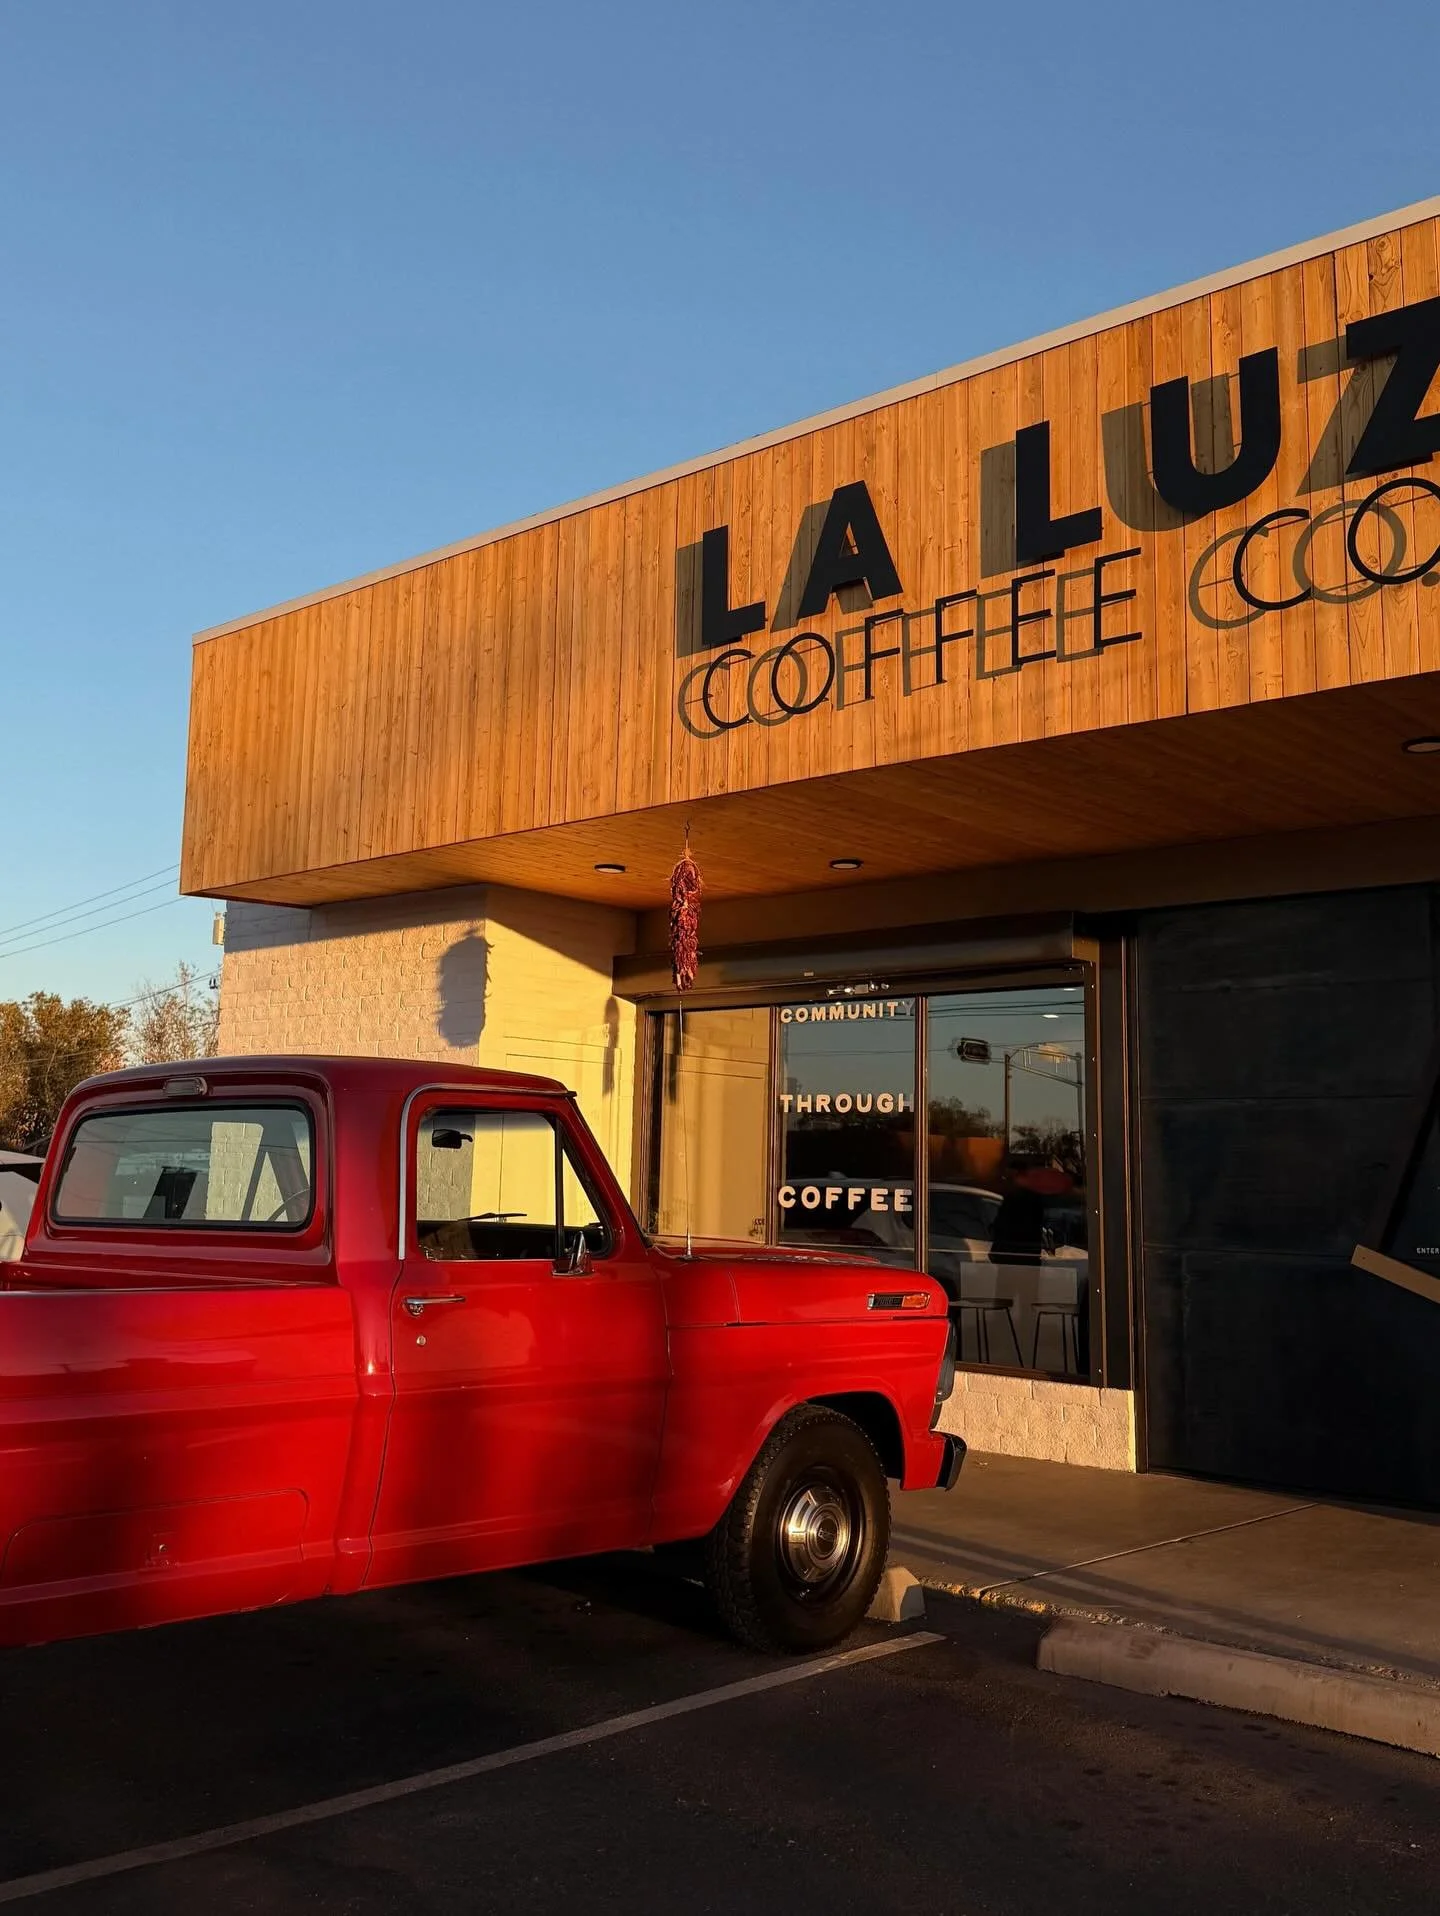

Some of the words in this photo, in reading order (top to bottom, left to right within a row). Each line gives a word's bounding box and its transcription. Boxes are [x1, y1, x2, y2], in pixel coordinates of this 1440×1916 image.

[702, 480, 904, 646] LA
[1016, 296, 1440, 563] LUZ
[703, 547, 1142, 729] COFFEE
[780, 999, 915, 1023] COMMUNITY
[779, 1093, 915, 1113] THROUGH
[778, 1185, 913, 1212] COFFEE
[1416, 1247, 1440, 1255] ENTER
